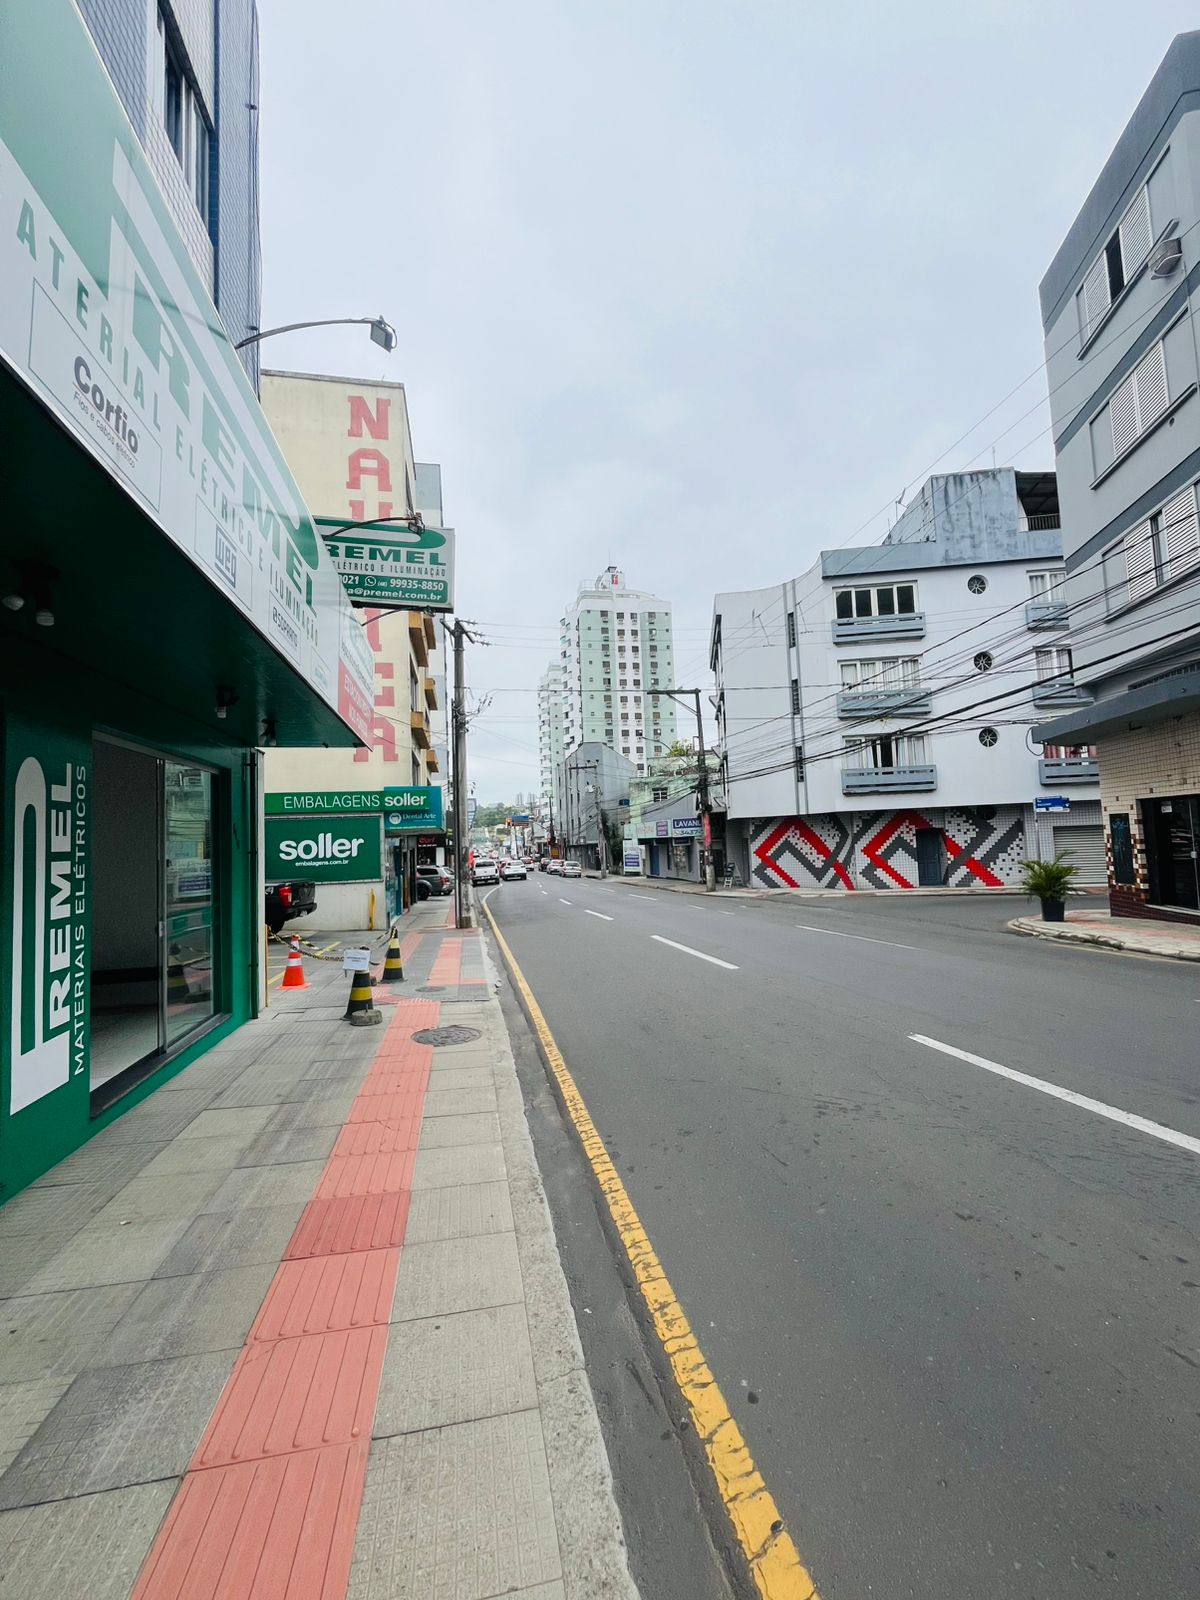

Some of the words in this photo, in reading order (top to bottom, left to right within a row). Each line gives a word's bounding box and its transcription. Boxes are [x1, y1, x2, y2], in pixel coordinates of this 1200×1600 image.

[74, 355, 139, 455] Corfio
[16, 198, 162, 433] ATERIAL
[175, 424, 253, 558] ELÉTRICO
[258, 548, 264, 572] E
[269, 569, 320, 647] ILUMINAÇÃO
[332, 560, 376, 573] LÉTRICO
[380, 564, 385, 573] E
[389, 565, 447, 578] ILUMINAÇÃO
[345, 587, 443, 601] a@premel.com.br
[389, 578, 445, 592] 99935-8850
[283, 795, 381, 809] EMBALAGENS
[384, 792, 427, 807] soller
[73, 765, 87, 915] ELÉTRICOS
[278, 832, 365, 861] soller
[295, 859, 349, 867] embalagens.com.br
[73, 924, 86, 1076] MATERIAIS
